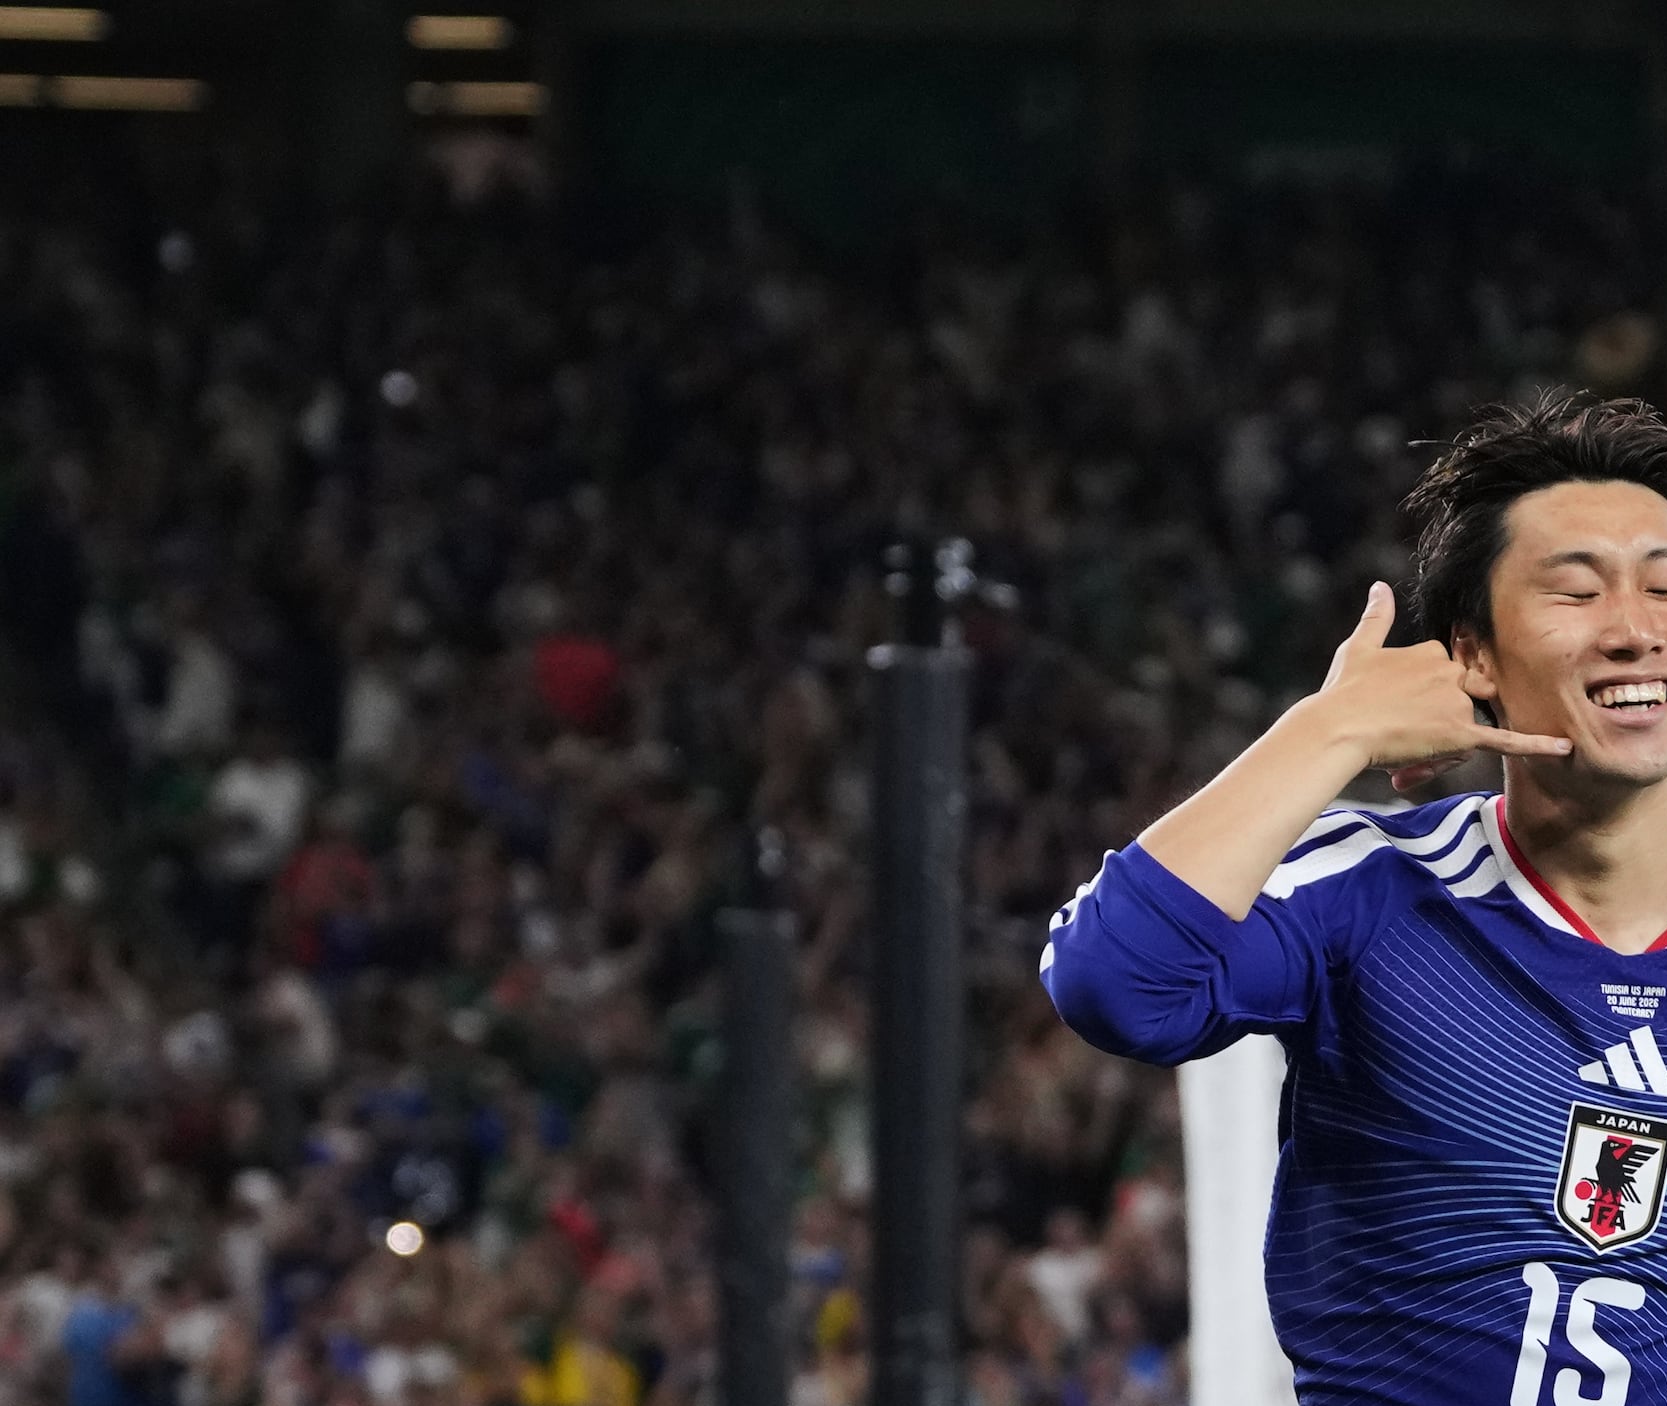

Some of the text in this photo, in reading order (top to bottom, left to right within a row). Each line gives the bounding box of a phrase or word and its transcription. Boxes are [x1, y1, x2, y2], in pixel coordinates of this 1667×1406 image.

[1600, 983, 1630, 995] TUNISIA
[1642, 986, 1667, 998] JAPAN
[1606, 995, 1660, 1009] 20 JUNE 2026
[1596, 1114, 1651, 1135] JAPAN
[1580, 1203, 1626, 1231] JFA
